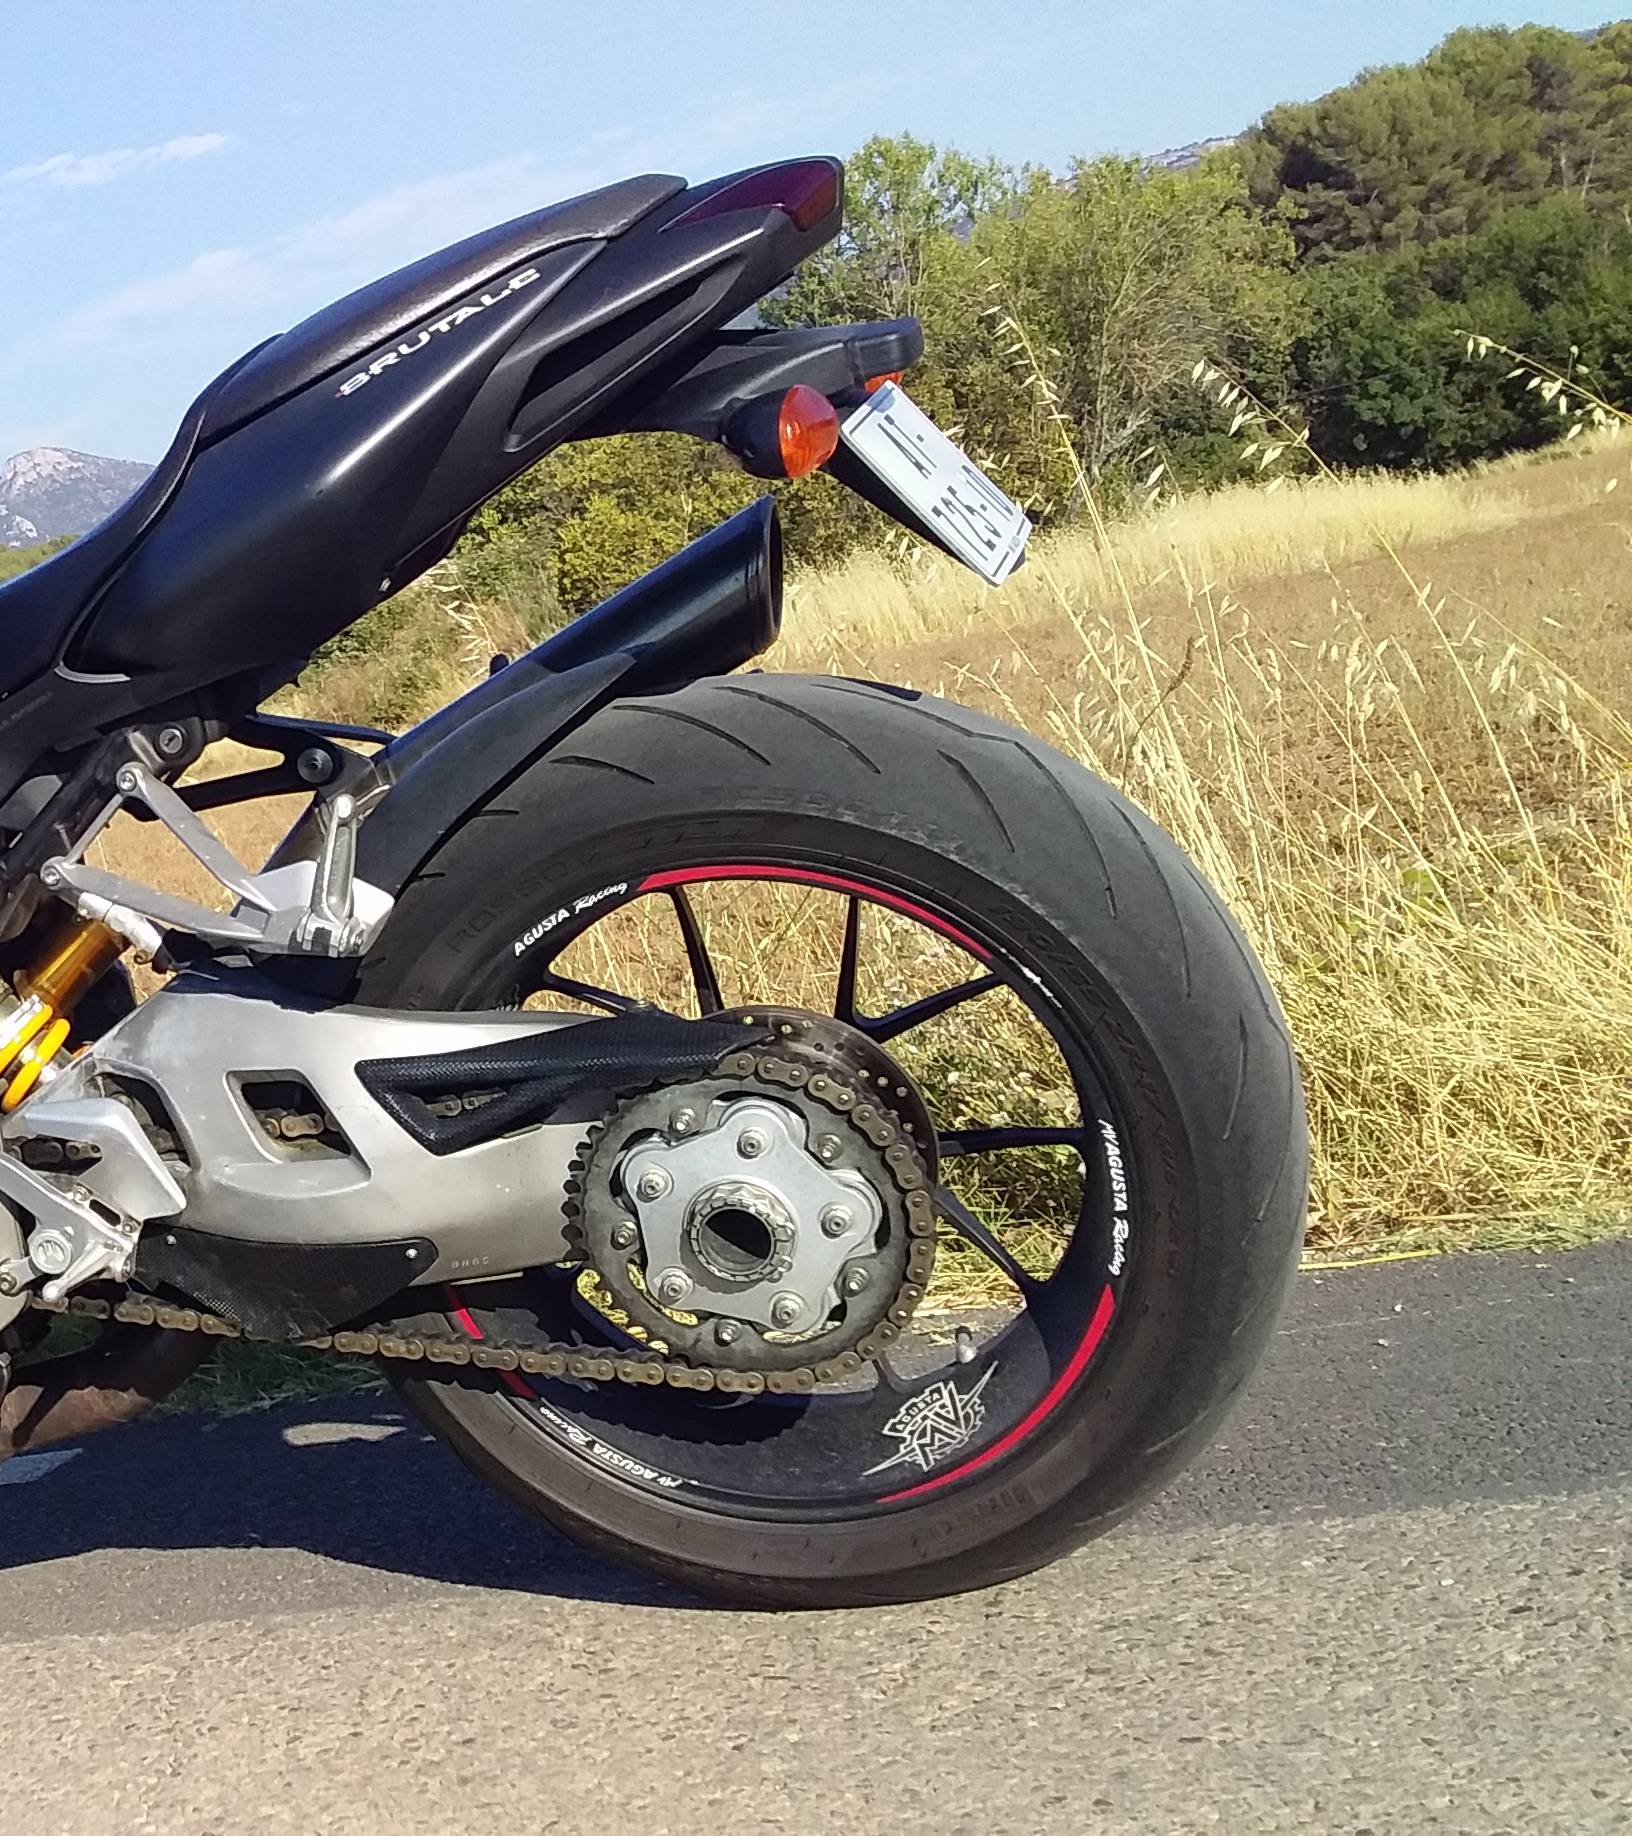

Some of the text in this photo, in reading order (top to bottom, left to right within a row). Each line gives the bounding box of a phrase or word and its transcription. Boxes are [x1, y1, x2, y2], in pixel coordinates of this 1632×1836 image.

[335, 267, 542, 398] BRUTALE
[514, 882, 628, 957] AGUSTA Racing
[1104, 1142, 1128, 1212] AGUSTA
[1108, 1216, 1129, 1276] Racing
[895, 1392, 941, 1431] AGUSTA
[592, 1443, 659, 1479] AGUSTA
